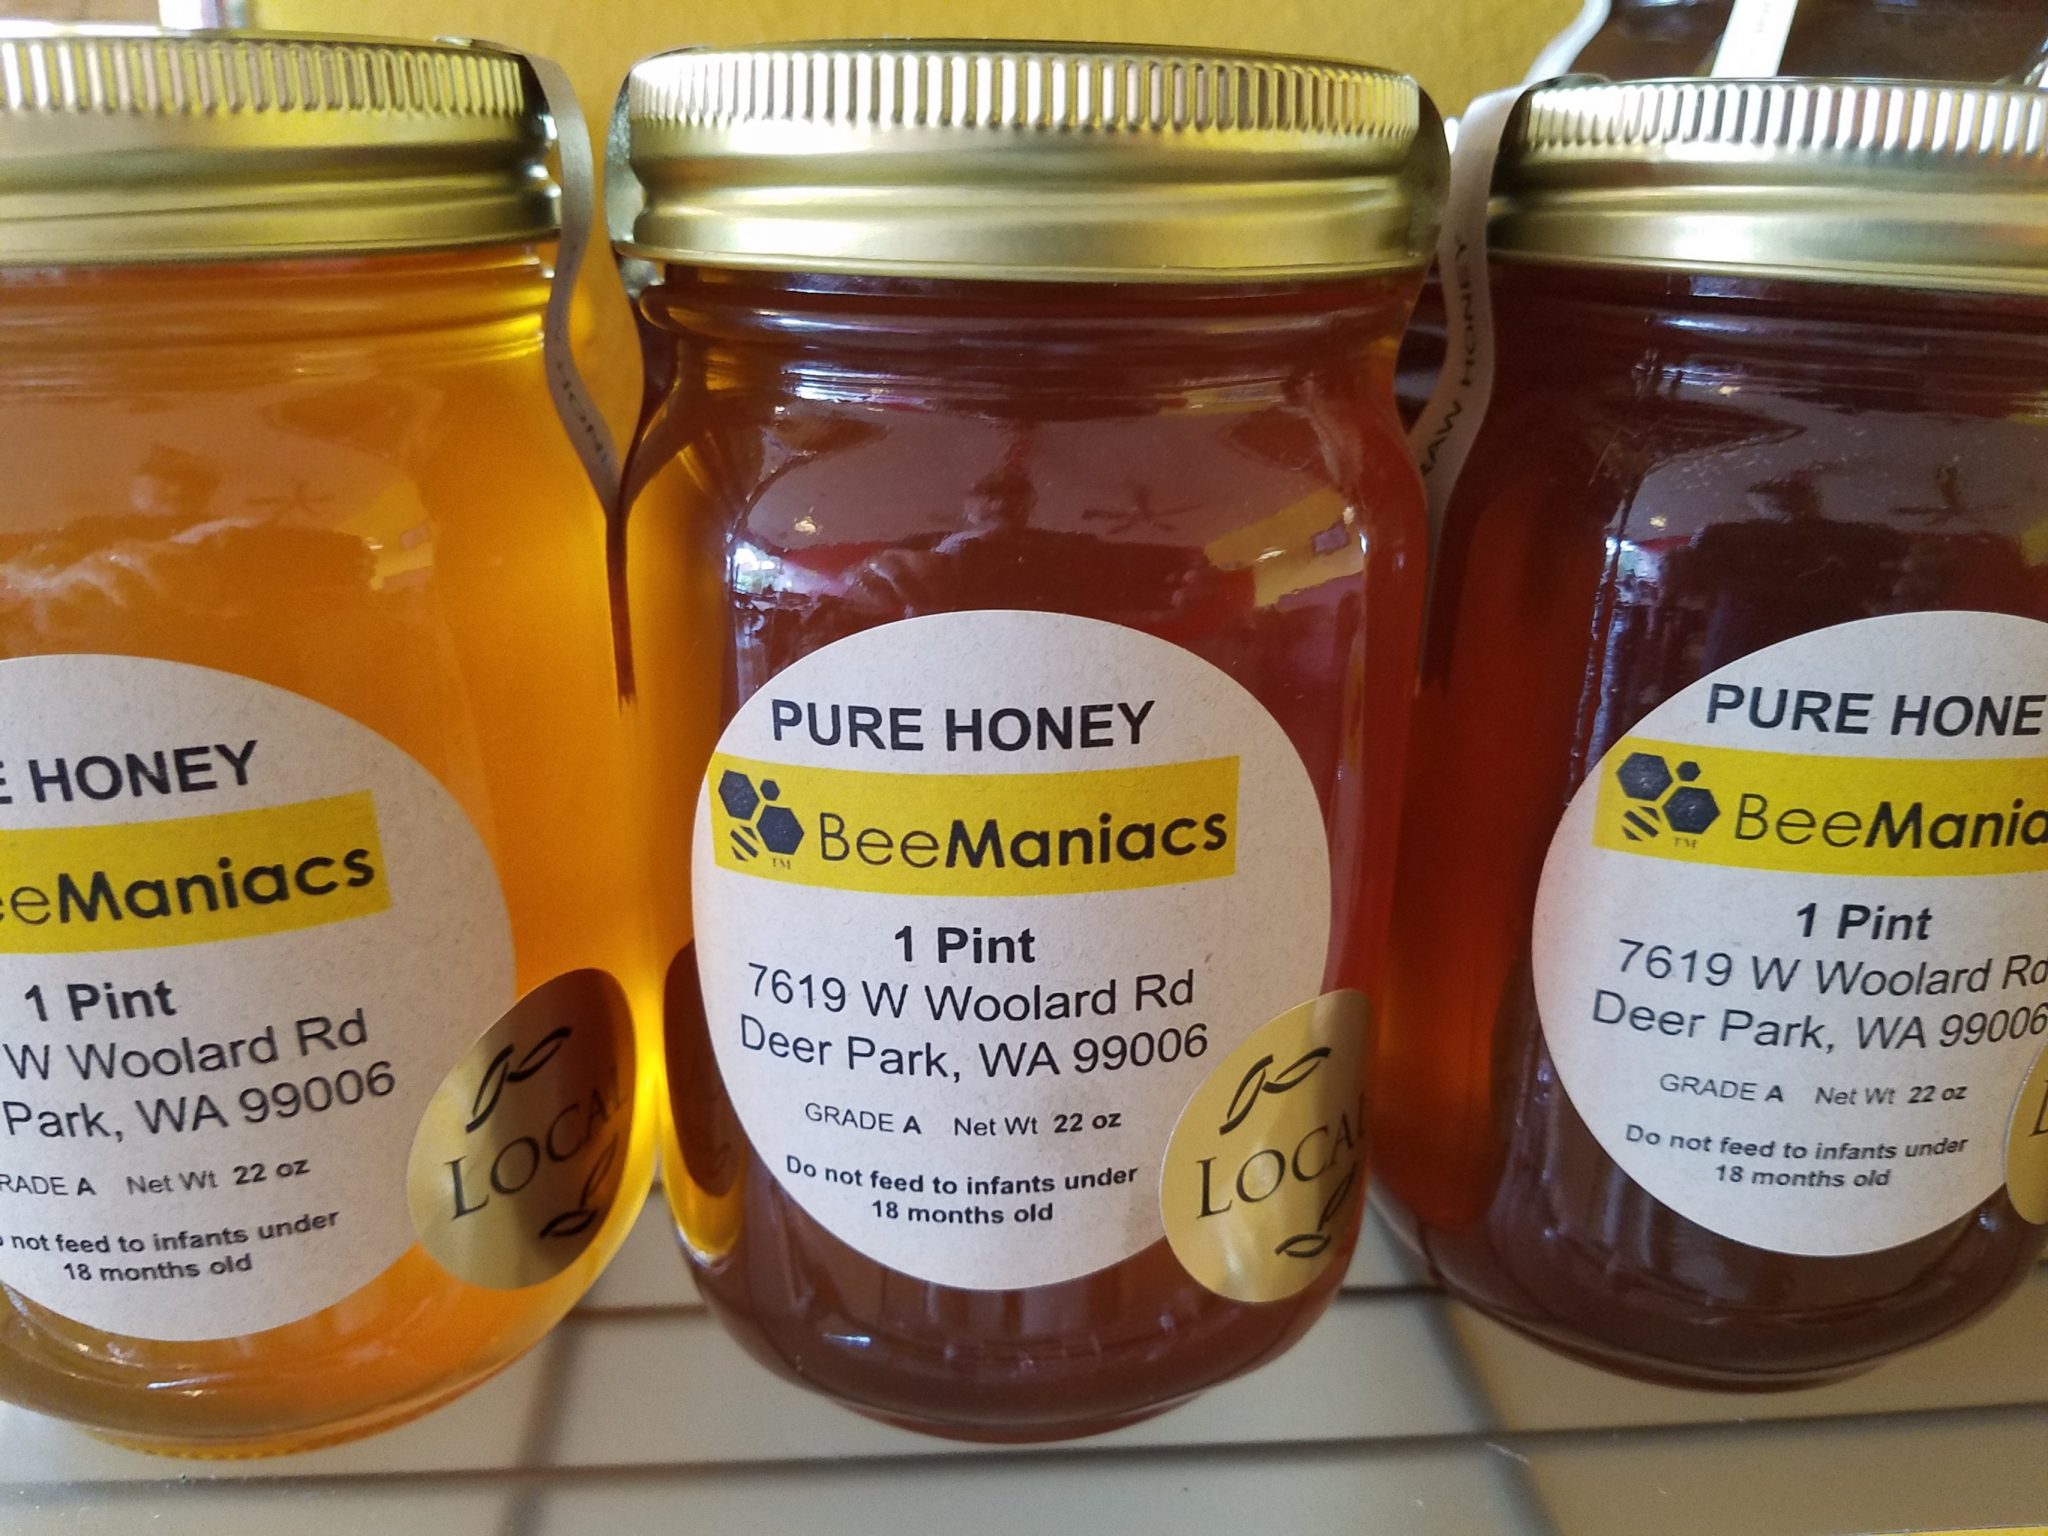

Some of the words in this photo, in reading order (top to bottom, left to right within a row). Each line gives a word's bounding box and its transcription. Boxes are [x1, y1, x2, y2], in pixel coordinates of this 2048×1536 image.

[771, 698, 924, 752] PURE
[945, 699, 1156, 752] HONEY
[1706, 683, 1875, 735] PURE
[1890, 694, 2048, 738] HONE
[28, 739, 259, 803] HONEY
[819, 811, 1228, 869] BeeManiacs
[0, 848, 376, 925] eManiacs
[894, 925, 913, 963] 1
[937, 926, 1036, 964] Pint
[1796, 902, 1817, 938] 1
[1837, 903, 1933, 941] Pint
[1619, 938, 1733, 987] 7619
[1751, 955, 1802, 993] W
[1816, 957, 1994, 997] Woolard
[24, 984, 49, 1022] 1
[66, 979, 178, 1022] Pint
[748, 962, 846, 1013] 7619
[861, 980, 909, 1019] W
[924, 978, 1117, 1022] Woolard
[1135, 968, 1194, 1012] Rd
[2, 1043, 51, 1081] W
[65, 1025, 280, 1081] Woolard
[295, 1007, 368, 1057] Rd
[1592, 989, 1707, 1038] Deer
[1720, 1008, 1835, 1055] Park,
[1857, 1015, 1927, 1050] WA
[1939, 1001, 2048, 1048] 99006
[740, 1013, 833, 1066] Deer
[847, 1035, 960, 1084] Park,
[978, 1041, 1061, 1078] WA
[1073, 1022, 1208, 1074] 99006
[2, 1100, 124, 1144] Park,
[134, 1094, 230, 1135] WA
[238, 1058, 396, 1124] 99006
[1659, 1073, 1758, 1102] GRADE
[1764, 1084, 1784, 1103] A
[1815, 1086, 1858, 1106] Net
[1865, 1087, 1897, 1105] Wt
[1907, 1084, 1937, 1104] 22
[1941, 1086, 1968, 1101] oz
[804, 1102, 894, 1133] GRADE
[902, 1115, 922, 1135] A
[954, 1117, 997, 1137] Net
[1004, 1116, 1039, 1136] Wt
[1053, 1112, 1084, 1134] 22
[1091, 1112, 1122, 1130] oz
[1625, 1123, 1662, 1146] Do
[1669, 1135, 1713, 1153] not
[1720, 1136, 1776, 1158] feed
[1783, 1142, 1808, 1159] to
[1815, 1142, 1898, 1160] infants
[1904, 1137, 1969, 1158] under
[442, 1068, 621, 1221] LOCA
[76, 1177, 97, 1196] A
[126, 1174, 175, 1195] Net
[178, 1170, 219, 1191] Wt
[232, 1162, 268, 1186] 22
[275, 1159, 311, 1179] oz
[786, 1154, 817, 1178] Do
[825, 1167, 863, 1187] not
[870, 1170, 924, 1193] feed
[932, 1176, 958, 1195] to
[967, 1175, 1056, 1196] infants
[1064, 1167, 1139, 1191] under
[1716, 1164, 1744, 1183] 18
[1751, 1169, 1846, 1188] months
[1853, 1168, 1892, 1187] old
[10, 1234, 51, 1252] not
[55, 1233, 111, 1254] feed
[117, 1235, 146, 1253] to
[152, 1227, 250, 1252] infants
[257, 1211, 340, 1240] under
[872, 1199, 899, 1220] 18
[907, 1205, 1005, 1225] months
[1013, 1202, 1054, 1223] old
[63, 1262, 93, 1281] 18
[99, 1260, 201, 1282] months
[209, 1252, 253, 1275] old
